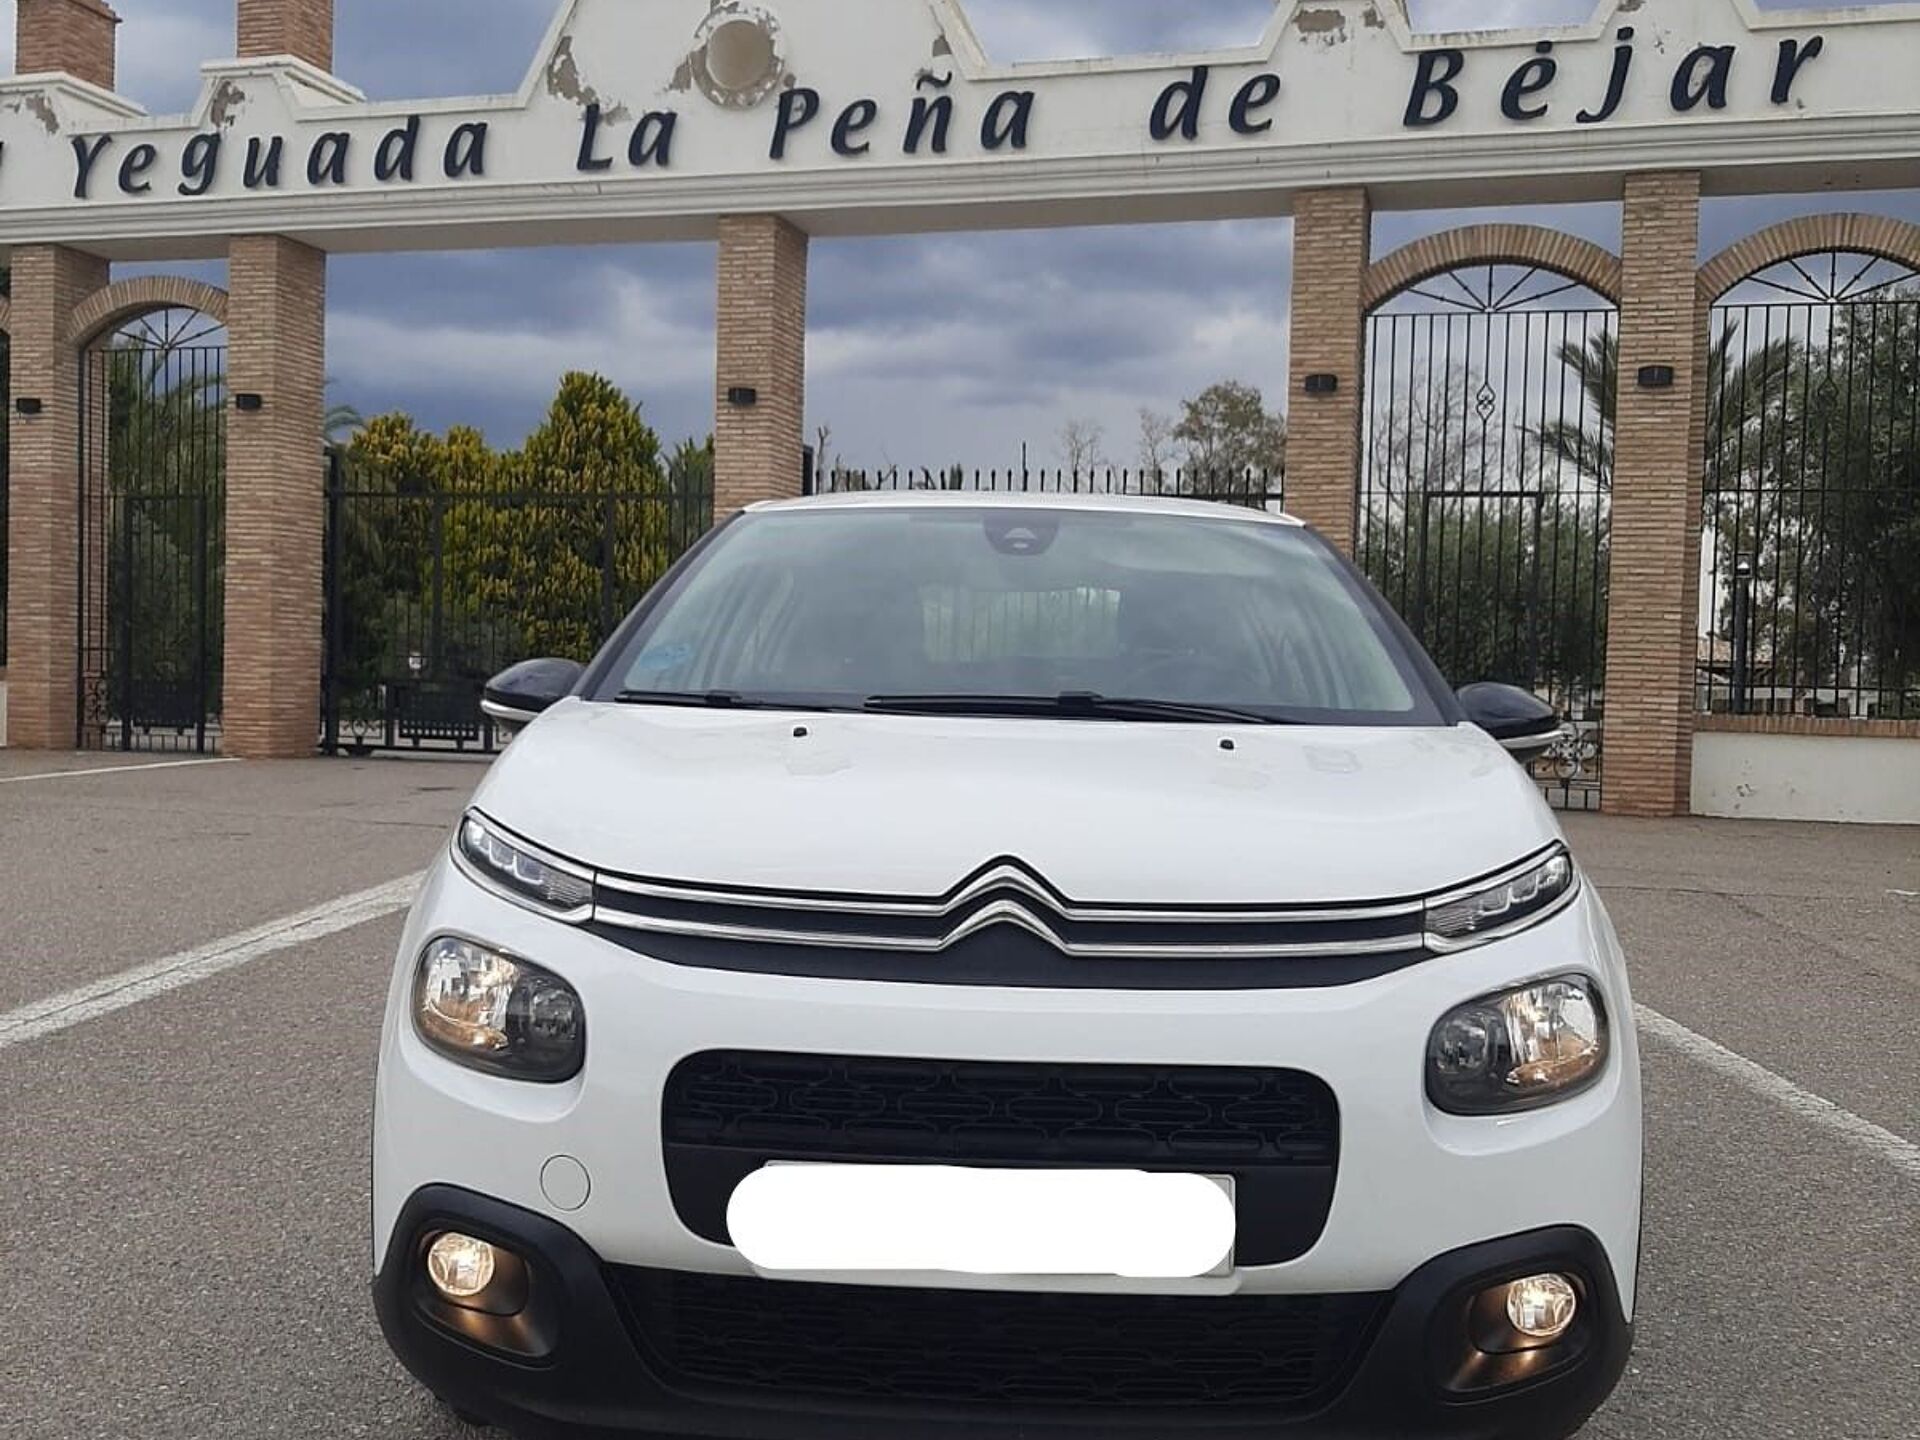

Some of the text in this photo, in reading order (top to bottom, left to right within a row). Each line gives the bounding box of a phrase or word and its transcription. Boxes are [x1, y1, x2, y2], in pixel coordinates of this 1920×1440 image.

[71, 115, 489, 198] Yeguada
[577, 104, 678, 171] La
[769, 71, 1035, 160] Peña
[1150, 66, 1281, 141] de
